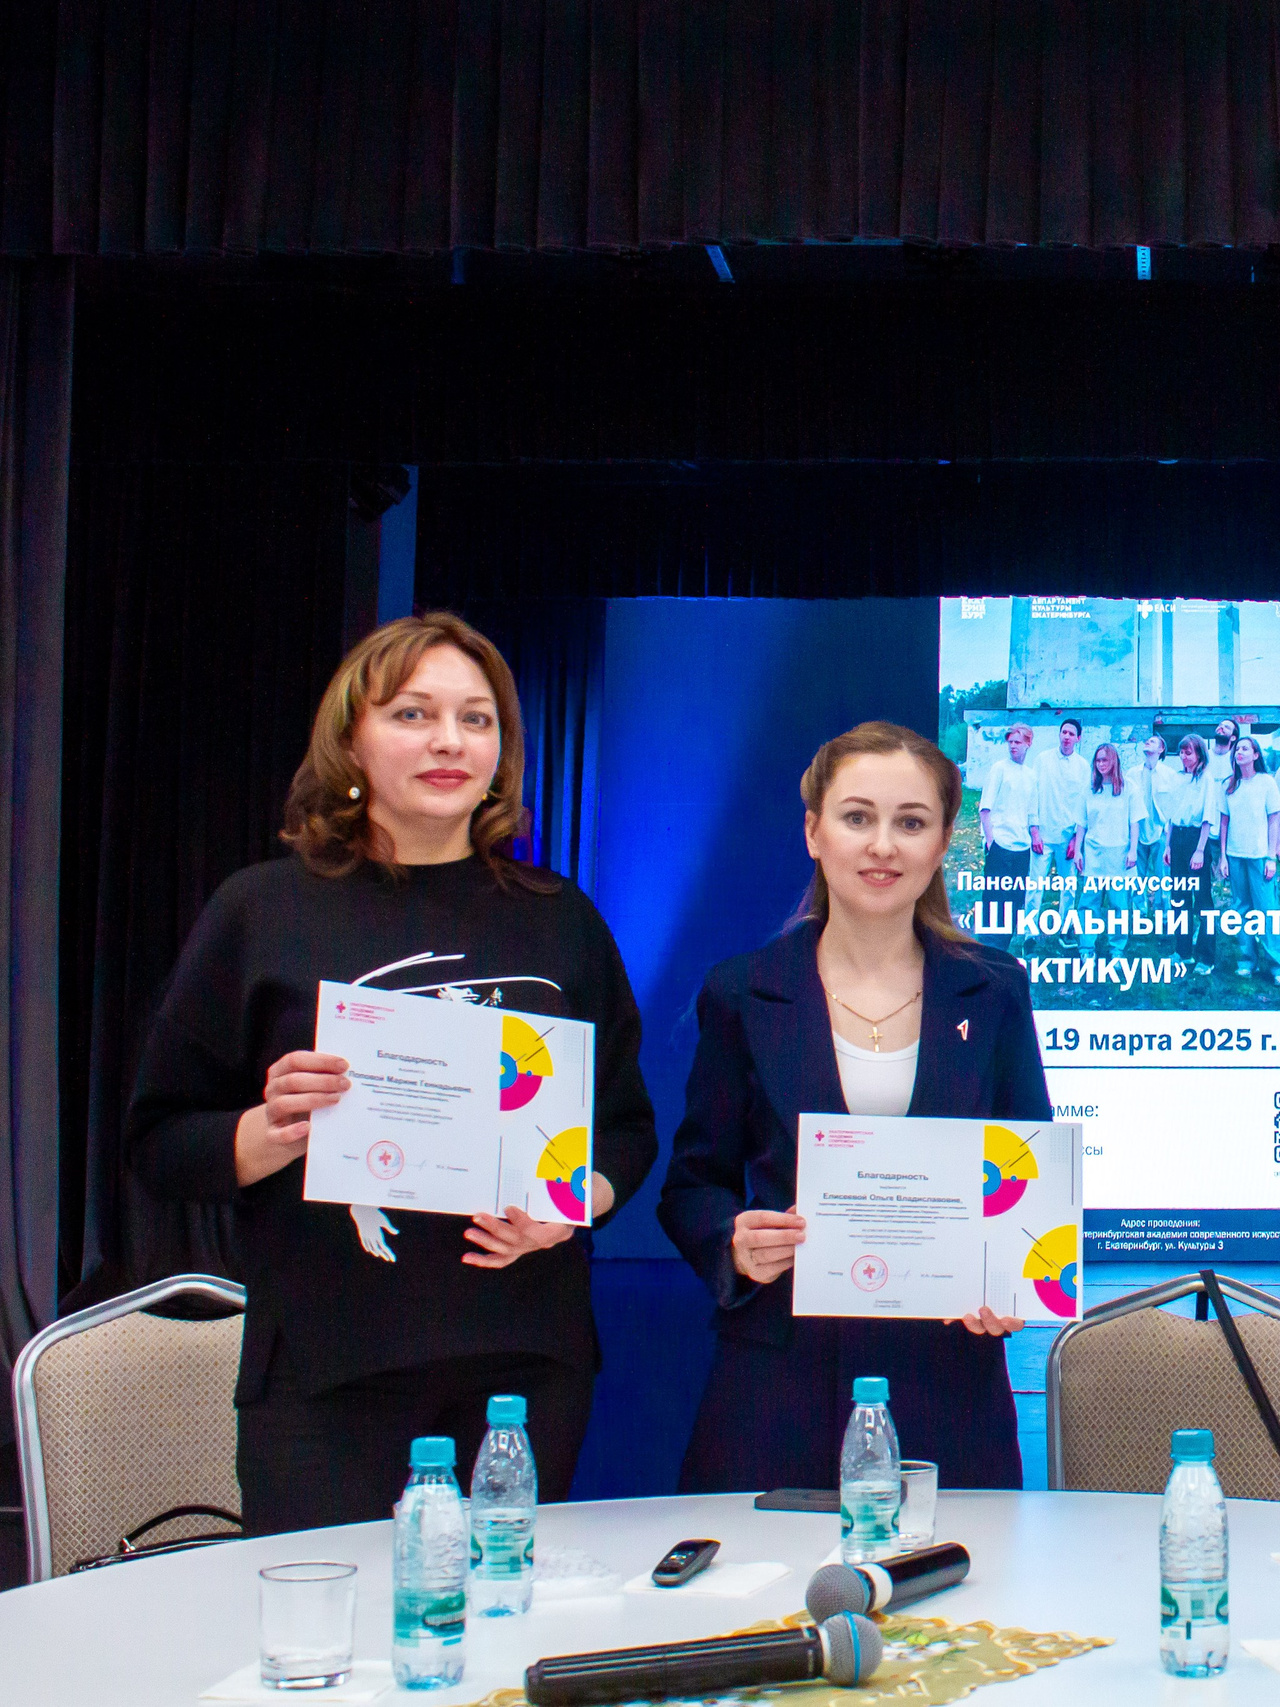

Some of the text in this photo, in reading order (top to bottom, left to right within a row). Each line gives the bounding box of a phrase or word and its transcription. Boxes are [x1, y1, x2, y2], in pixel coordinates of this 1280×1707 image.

[957, 871, 1200, 895] Панельная дискуссия
[958, 900, 1189, 935] «Школьный
[1045, 1028, 1277, 1056] 19 марта 2025 г.
[377, 1049, 448, 1067] Благодарность
[857, 1170, 929, 1181] Благодарность
[869, 1194, 894, 1202] Ольге
[1121, 1218, 1201, 1229] Адрес проведения:
[1147, 1231, 1188, 1239] академия
[1190, 1231, 1250, 1240] современного
[1165, 1242, 1176, 1251] ул.
[1178, 1241, 1216, 1251] Культуры
[1217, 1241, 1224, 1250] 3
